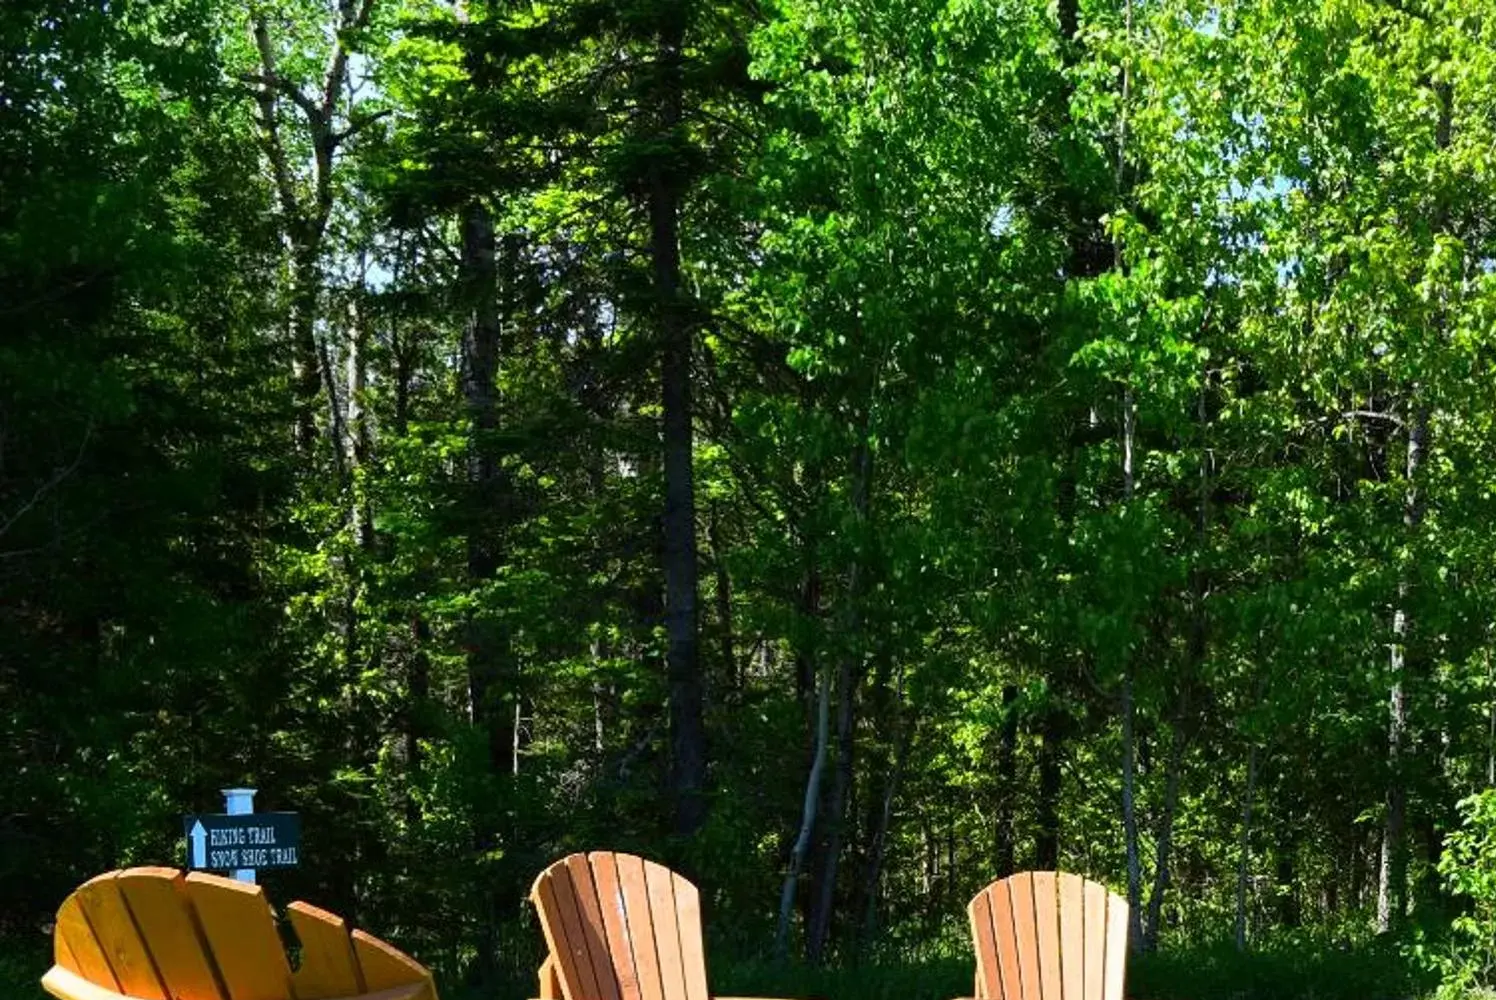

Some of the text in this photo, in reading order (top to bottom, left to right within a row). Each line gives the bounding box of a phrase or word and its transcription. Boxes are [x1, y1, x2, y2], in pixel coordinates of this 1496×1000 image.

[210, 826, 276, 846] HIKING TRAIL
[210, 847, 298, 868] SNOW SHOE TRAIL
